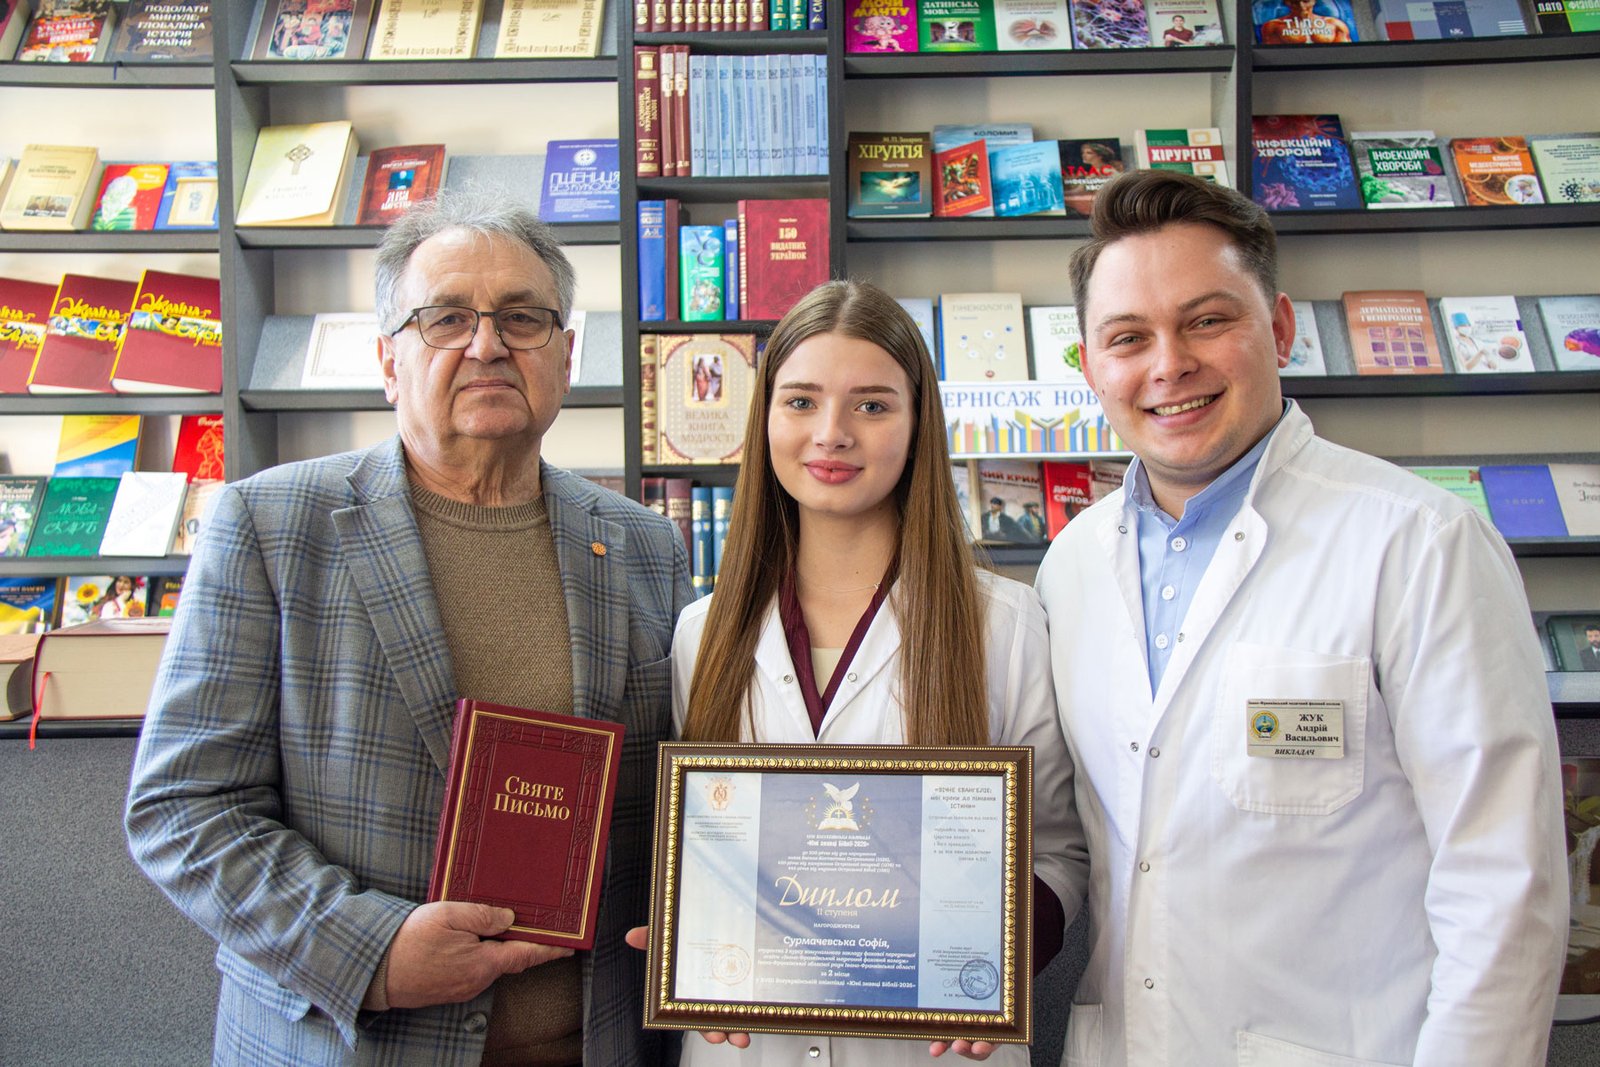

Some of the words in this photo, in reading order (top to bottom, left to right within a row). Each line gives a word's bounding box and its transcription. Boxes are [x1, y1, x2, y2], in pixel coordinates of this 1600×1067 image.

[145, 5, 209, 13] ПОДОЛАТИ
[853, 7, 909, 17] МАНТУ
[138, 22, 206, 30] ГЛОБАЛЬНА
[1283, 16, 1325, 29] ТІЛО
[147, 30, 193, 38] ІСТОРІЯ
[143, 38, 193, 46] УКРАЇНИ
[1256, 138, 1332, 148] ІНФЕКЦІЙНІ
[859, 145, 923, 161] ХІРУРГІЯ
[1151, 148, 1212, 161] ХІРУРГІЯ
[1258, 148, 1322, 157] ХВОРОБИ
[1372, 149, 1431, 160] ІНФЕКЦІЙНІ
[1375, 160, 1422, 171] ХВОРОБИ
[778, 227, 798, 239] 150
[770, 242, 807, 251] ВИДАТНИХ
[770, 251, 807, 260] УКРАЇНОК
[945, 391, 1041, 408] ЕРНІСАЖ
[689, 422, 726, 430] КНИГА
[681, 434, 735, 443] МУДРОСТІ
[1053, 485, 1084, 495] ДРУГА
[1299, 714, 1324, 722] ЖУК
[1295, 724, 1328, 734] Андрій
[1285, 734, 1339, 743] Васильович
[775, 873, 902, 908] Диплом
[824, 909, 858, 919] ступеня
[783, 936, 856, 949] Сурмачевська
[858, 938, 890, 950] Софія,
[828, 969, 833, 977] 2
